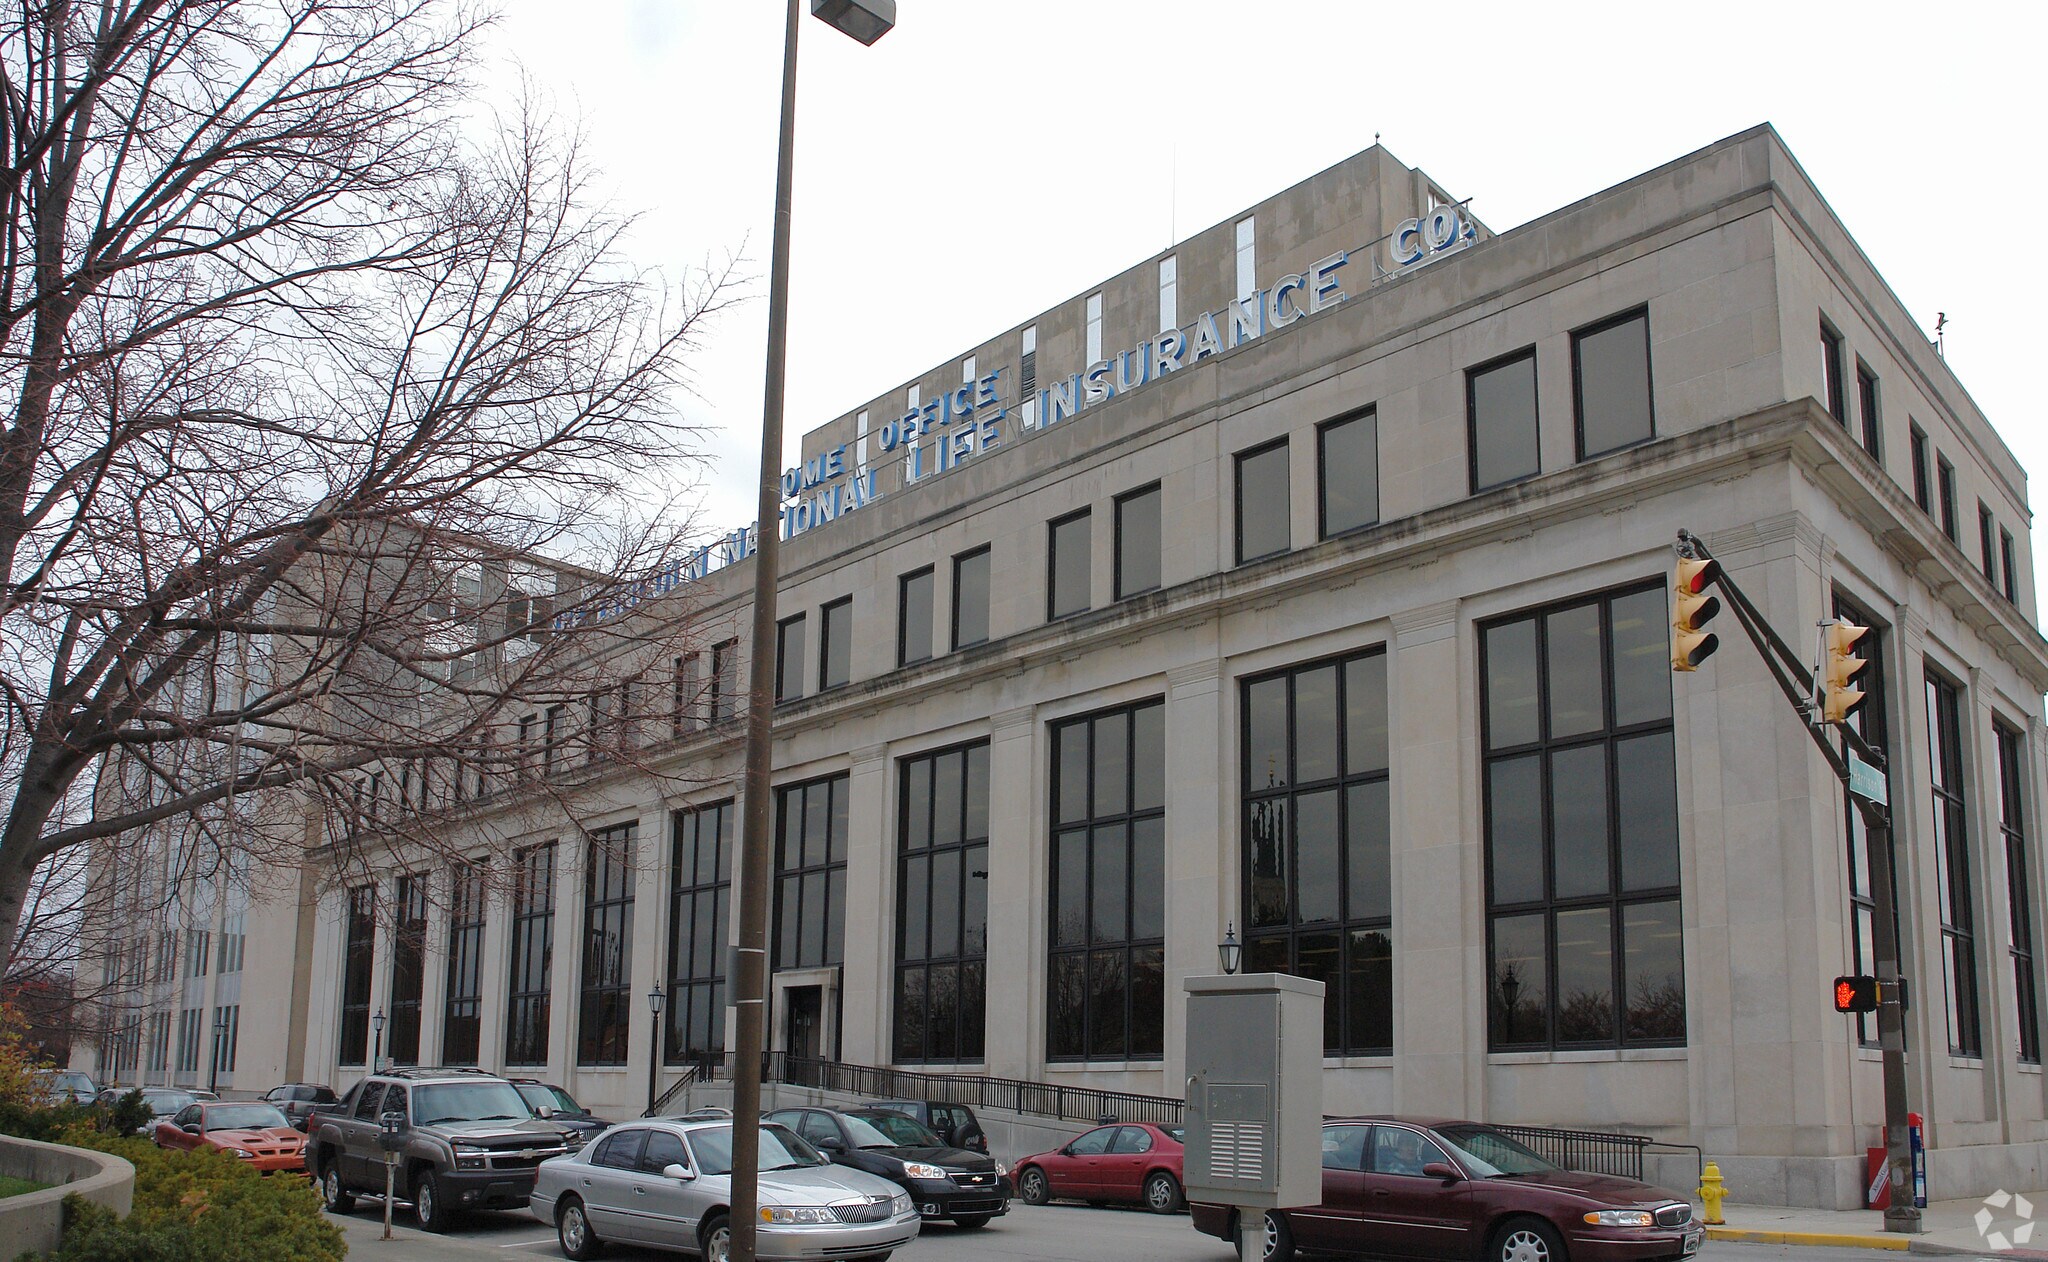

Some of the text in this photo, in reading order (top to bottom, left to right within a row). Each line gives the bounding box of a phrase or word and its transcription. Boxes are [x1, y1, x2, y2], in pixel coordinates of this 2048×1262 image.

[725, 204, 1476, 566] NAIONAL LIFE INSURANCE CO.
[780, 369, 999, 501] OME OFFICE
